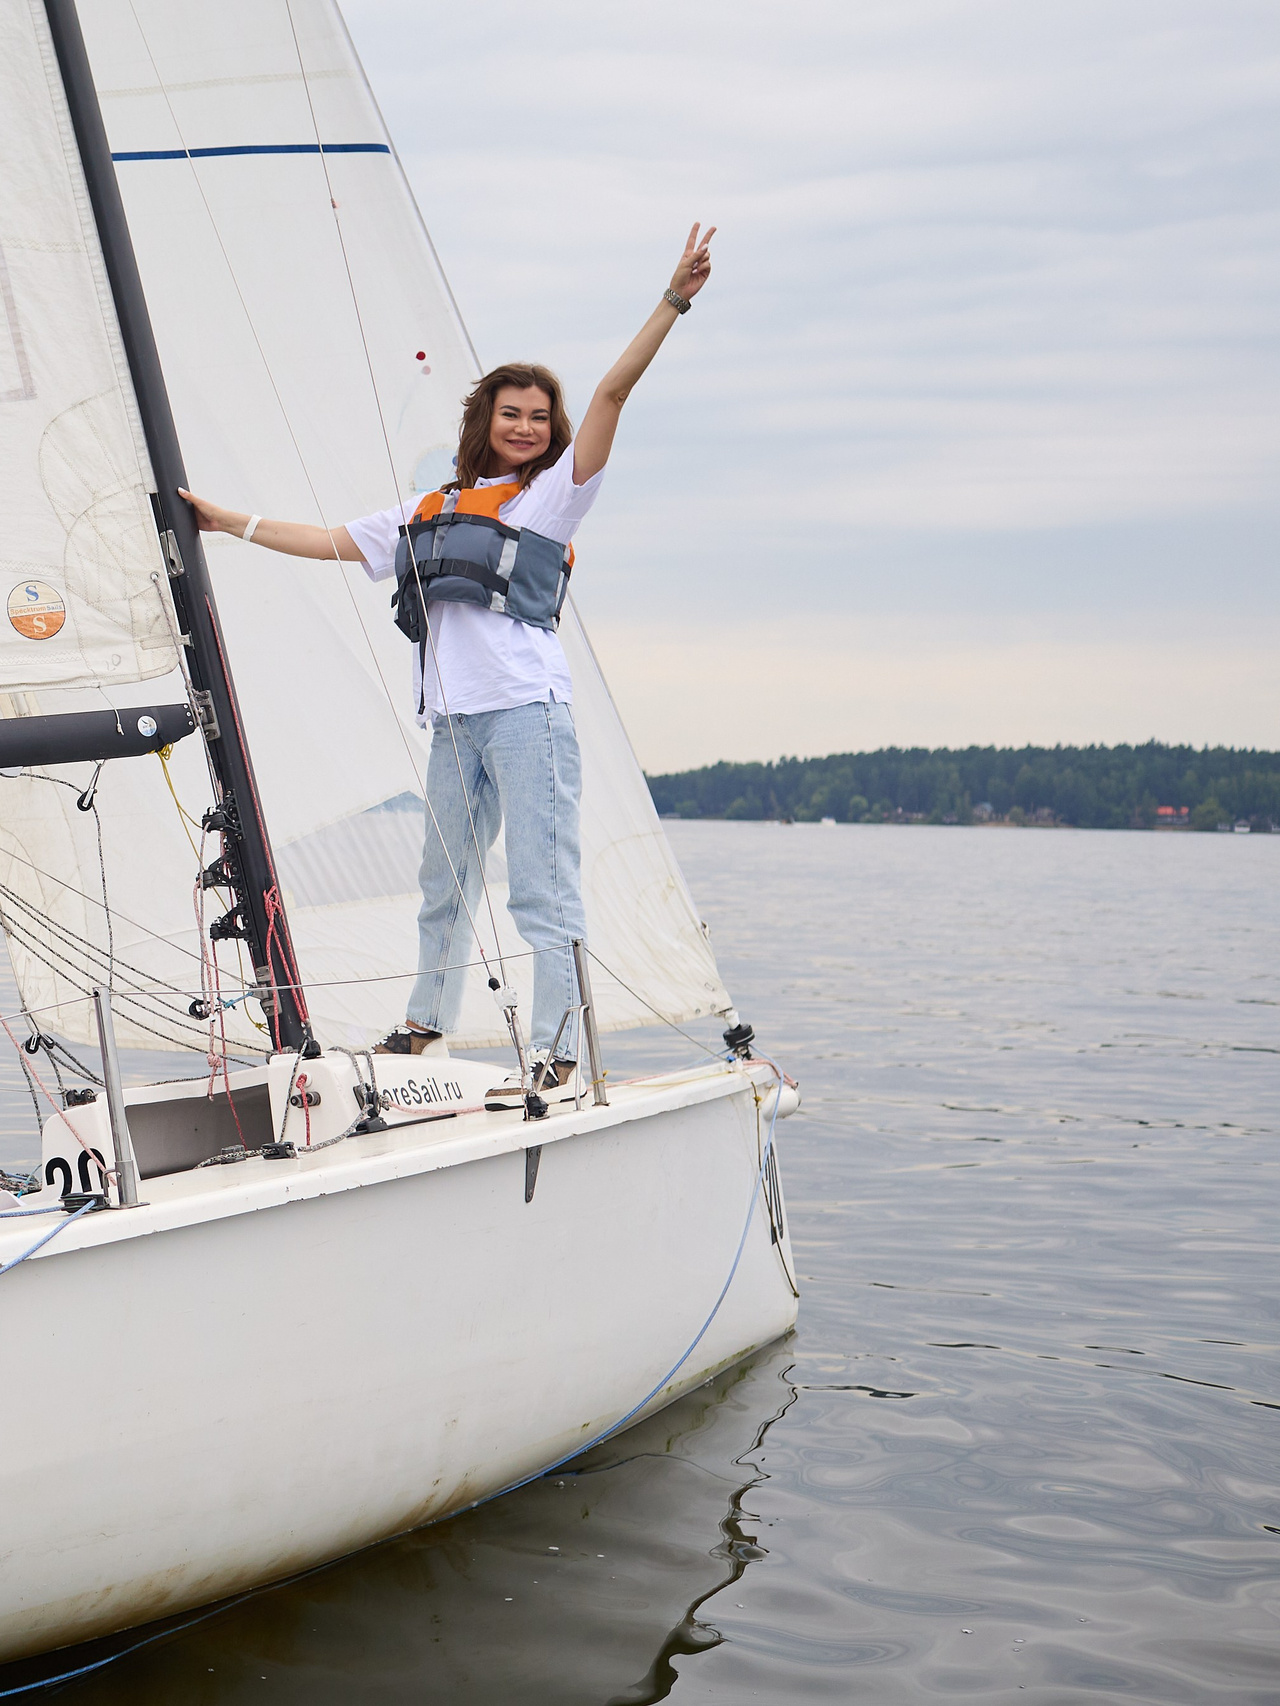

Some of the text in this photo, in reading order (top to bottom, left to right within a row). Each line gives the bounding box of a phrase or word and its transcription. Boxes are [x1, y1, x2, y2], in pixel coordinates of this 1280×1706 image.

[25, 585, 39, 602] S
[33, 615, 47, 634] S
[382, 1077, 463, 1106] oreSail.ru
